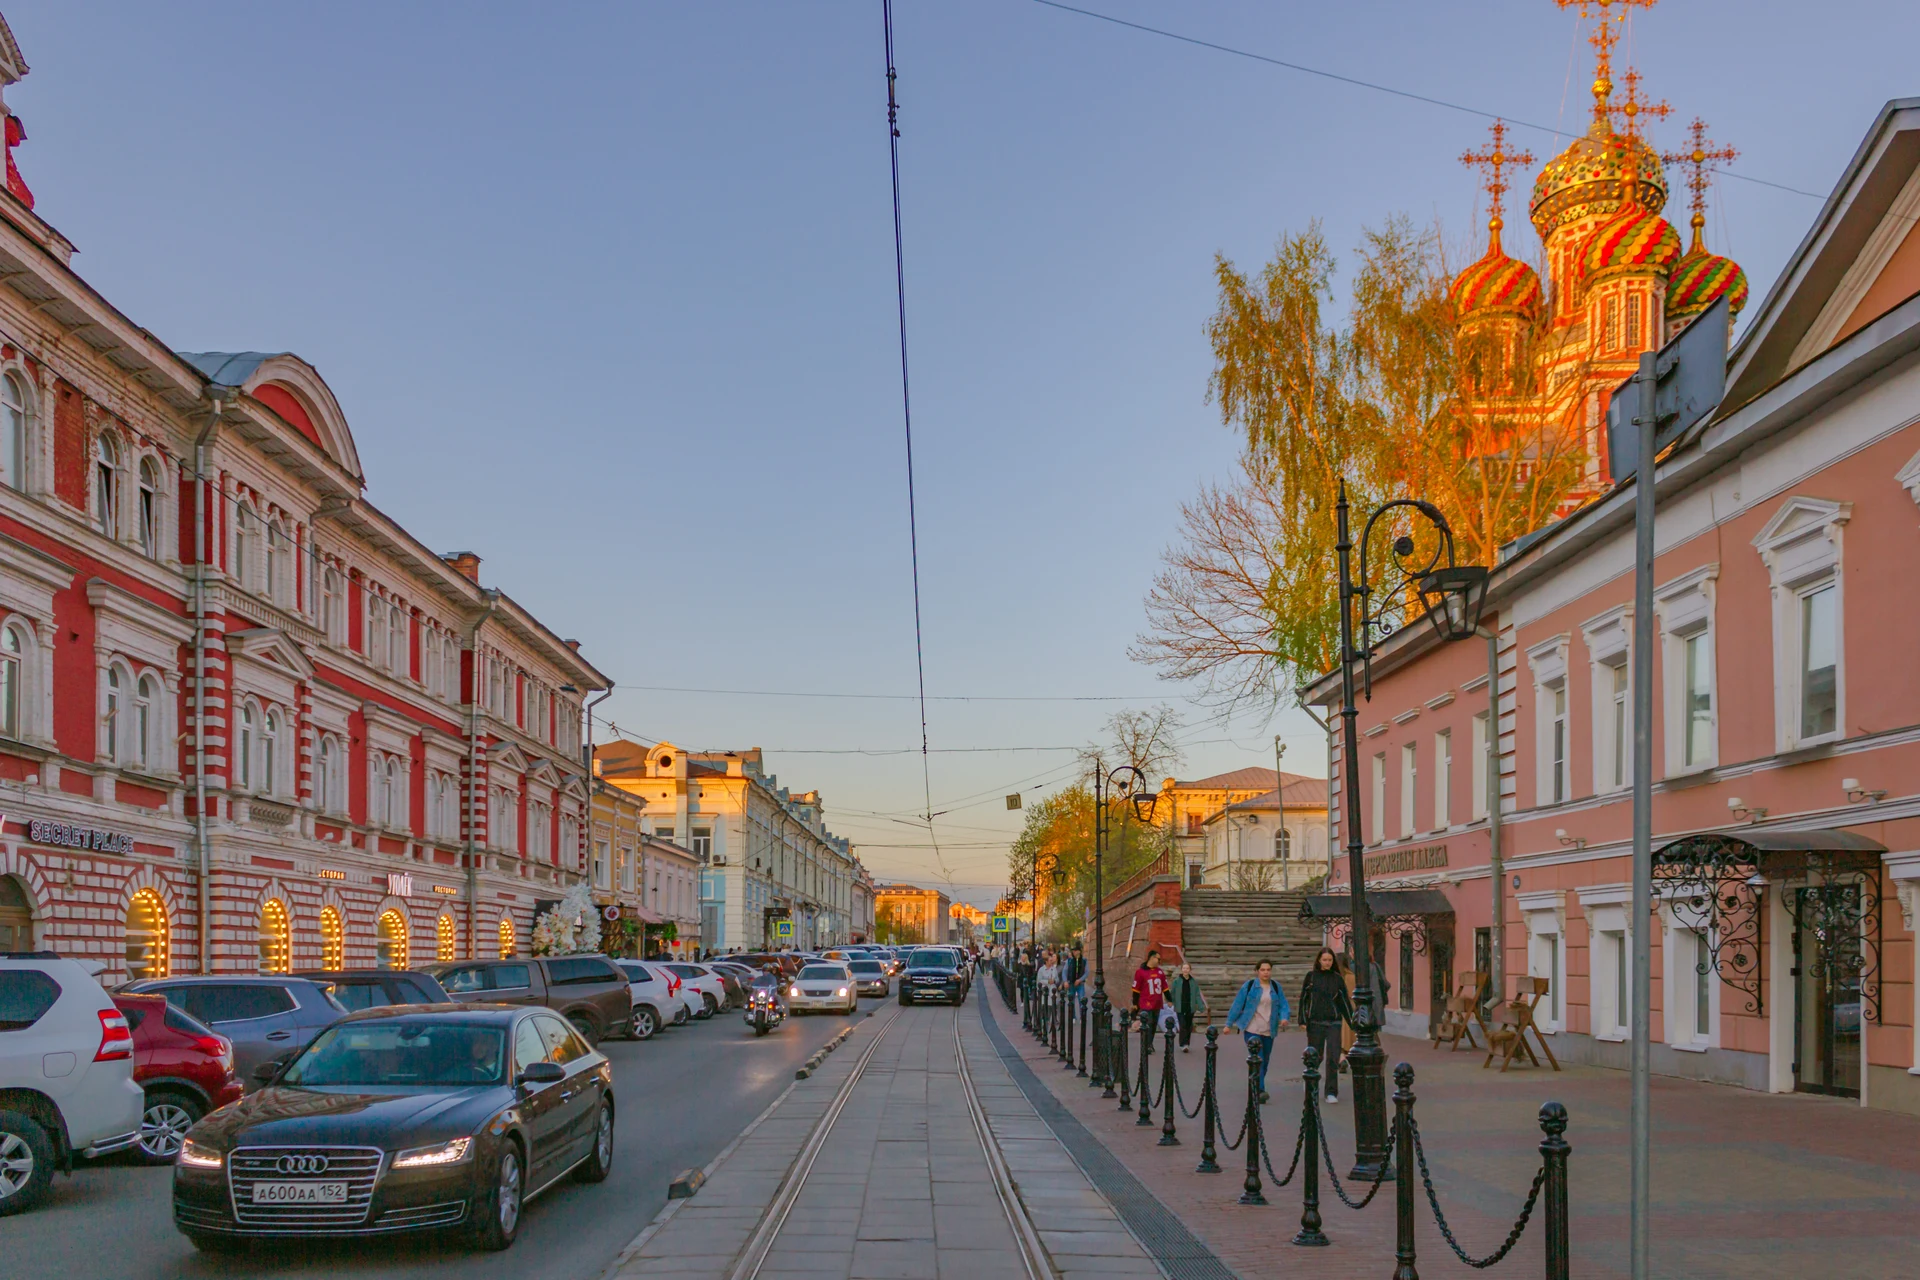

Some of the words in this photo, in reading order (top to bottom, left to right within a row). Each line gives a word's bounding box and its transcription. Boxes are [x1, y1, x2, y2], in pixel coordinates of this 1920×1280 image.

[31, 819, 91, 849] SECRET
[92, 830, 135, 854] PLACE
[1147, 978, 1162, 995] 13
[258, 1185, 317, 1200] А600АА
[319, 1184, 343, 1197] 152
